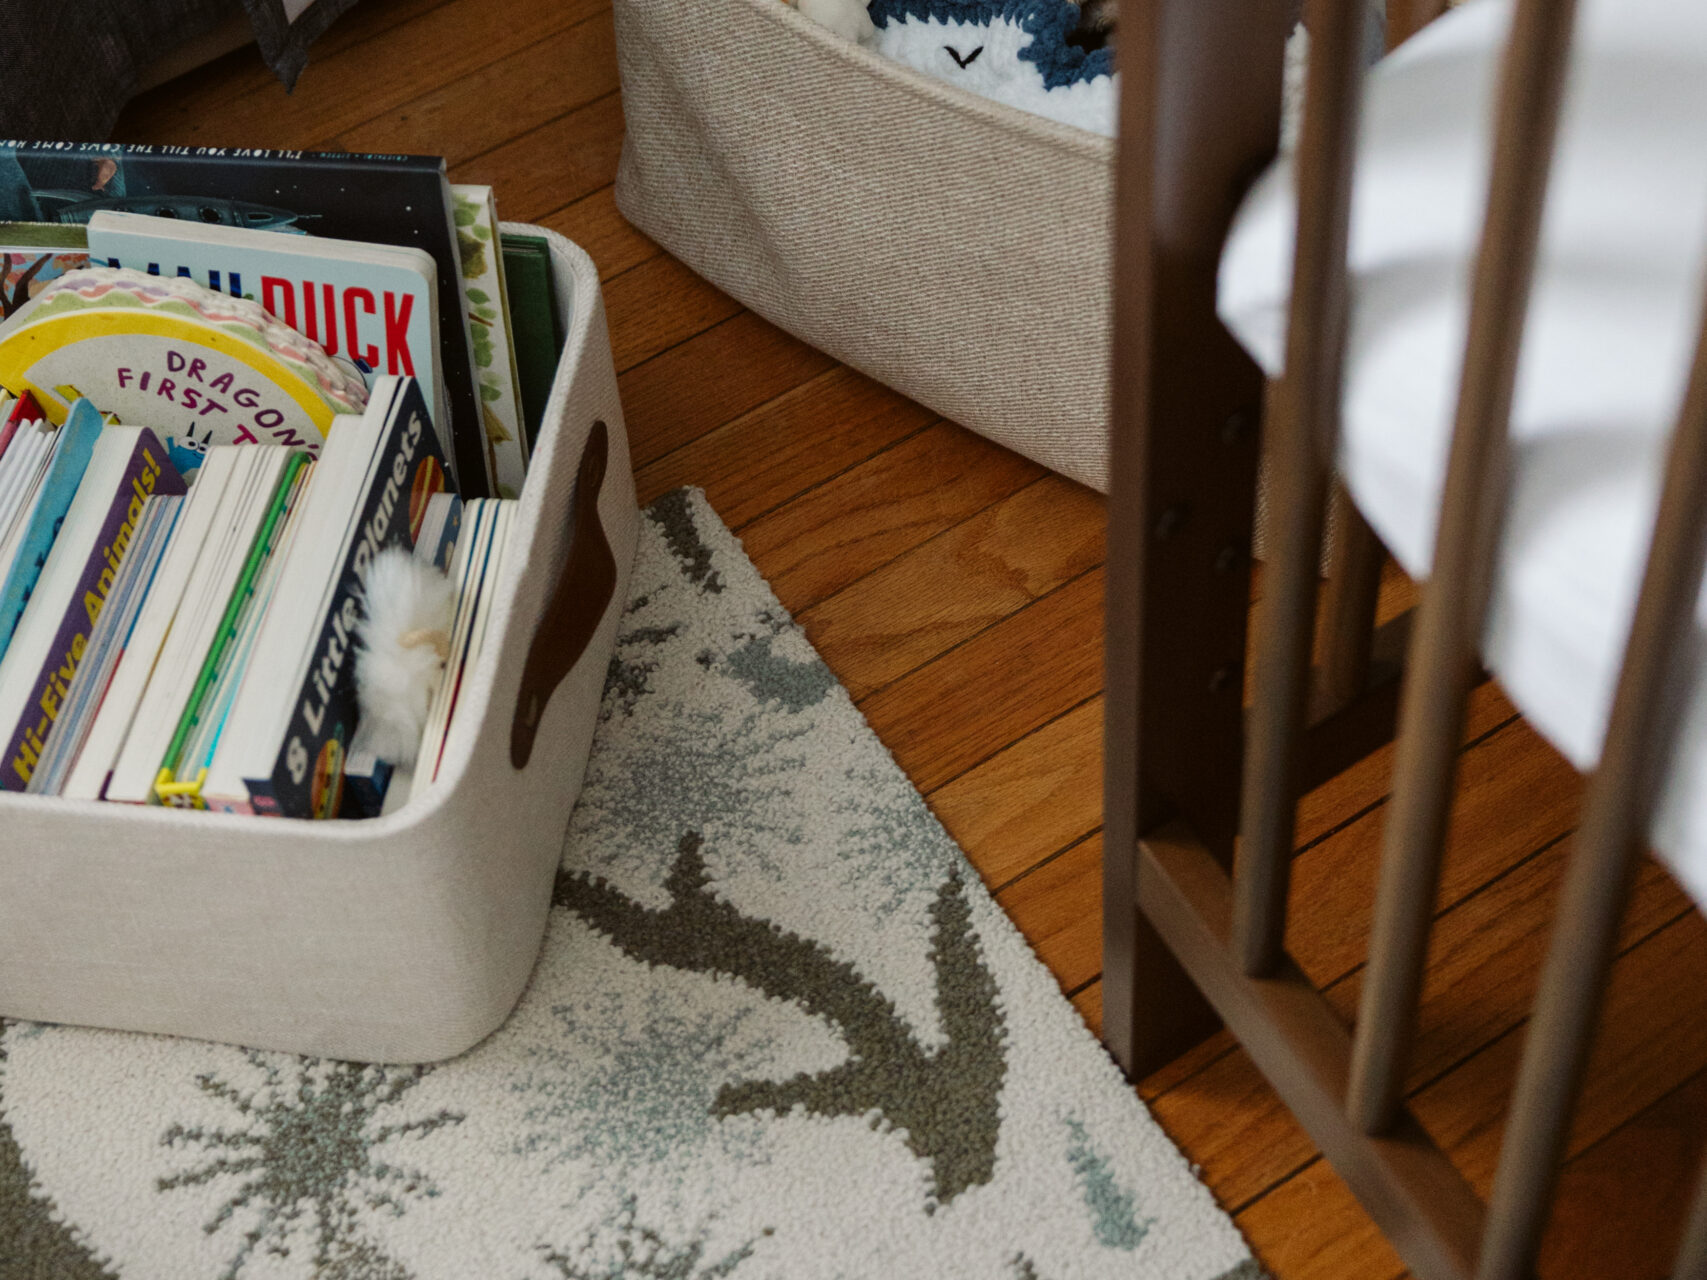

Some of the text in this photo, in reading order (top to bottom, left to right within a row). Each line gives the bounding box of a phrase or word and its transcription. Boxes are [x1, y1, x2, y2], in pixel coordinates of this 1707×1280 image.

[32, 140, 73, 151] COME
[79, 142, 120, 153] COWS
[127, 144, 153, 154] THE
[161, 145, 190, 155] TILL
[196, 146, 227, 157] YOU
[233, 148, 270, 158] LOVE
[278, 150, 303, 160] I'LL
[261, 275, 415, 377] DUCK
[117, 368, 228, 416] FIRST
[167, 350, 319, 461] DRAGON'
[286, 410, 422, 786] 8 Little Planets
[12, 632, 88, 784] Hi-Five
[83, 447, 161, 630] Animals!
